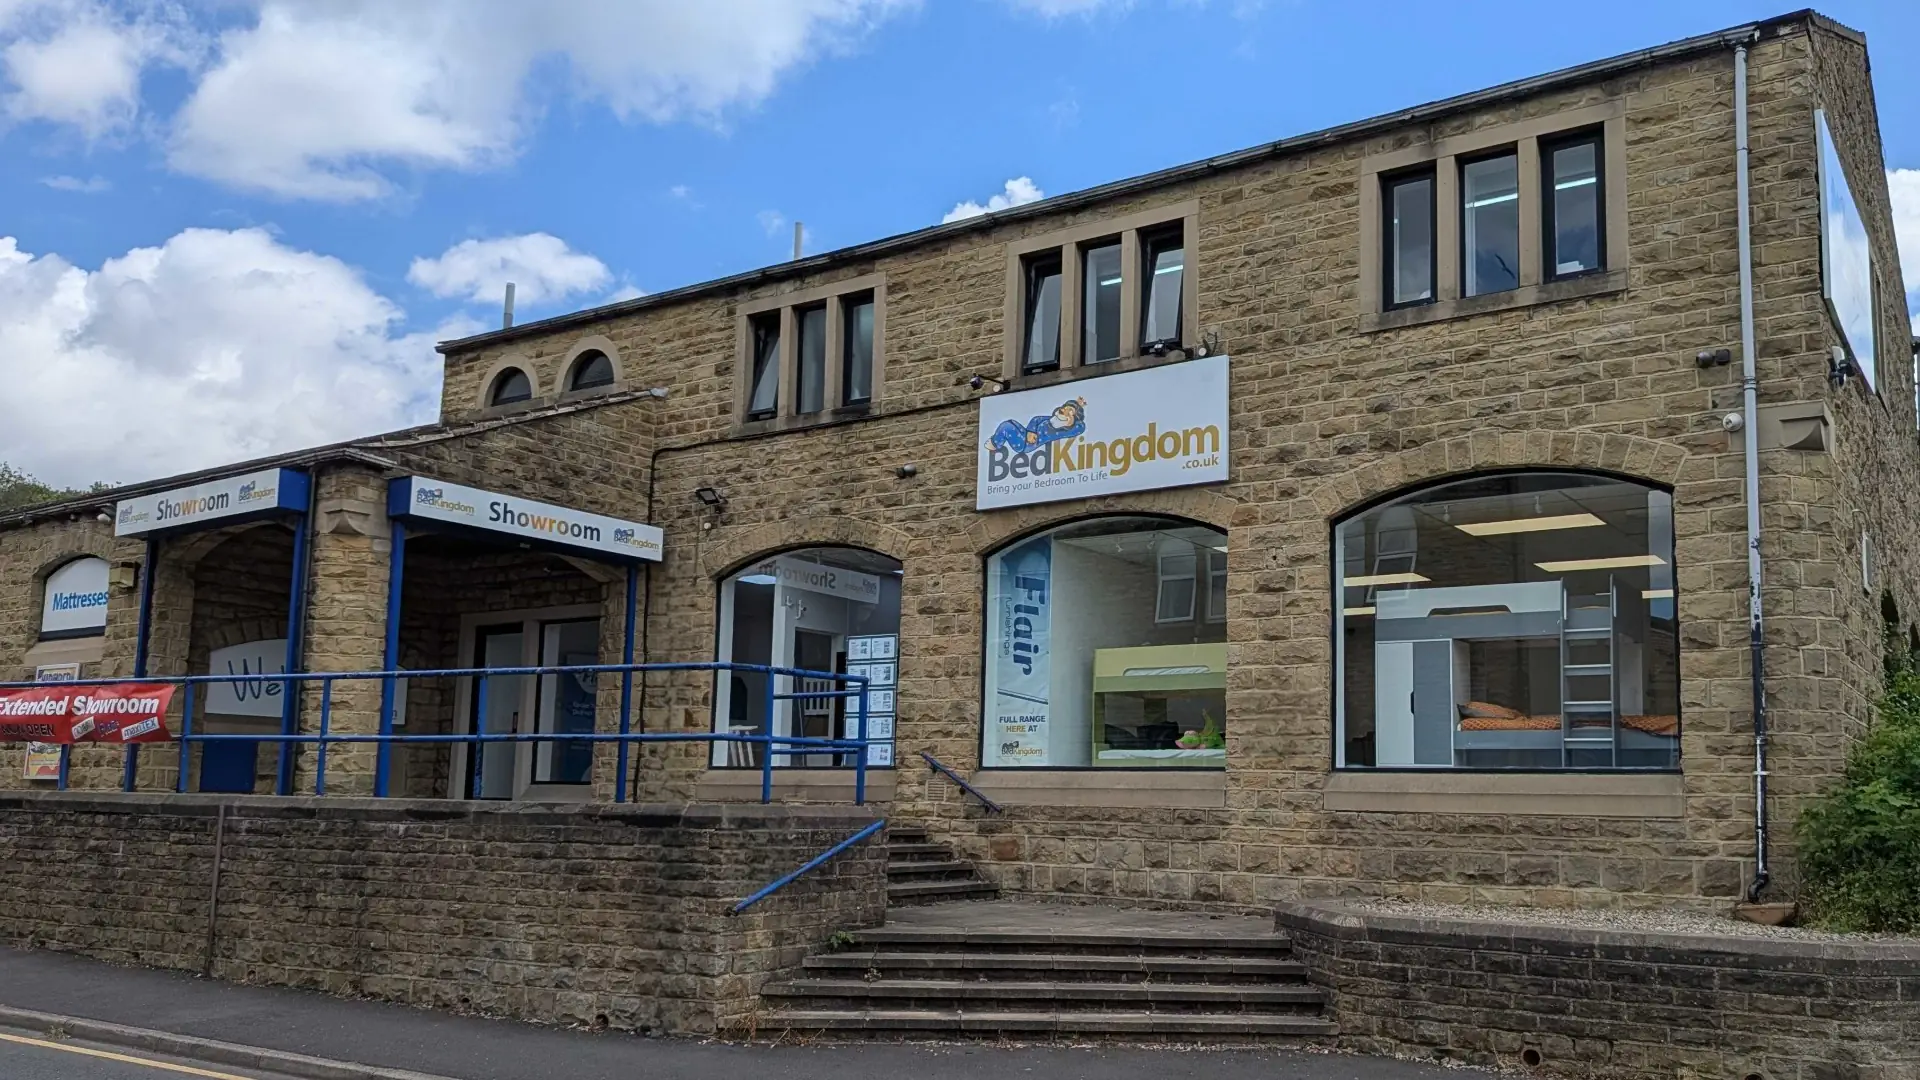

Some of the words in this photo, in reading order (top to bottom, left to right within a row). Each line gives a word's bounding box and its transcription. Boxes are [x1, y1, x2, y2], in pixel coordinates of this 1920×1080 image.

[987, 422, 1219, 482] BedKingdom
[1182, 455, 1219, 470] .co.uk
[987, 485, 1010, 495] Bring
[1012, 482, 1033, 493] your
[1034, 476, 1075, 488] Bedroom
[1077, 473, 1089, 482] To
[1090, 470, 1108, 481] Life
[156, 491, 229, 521] Showroom
[489, 501, 600, 542] Showroom
[52, 590, 110, 611] Mattresses
[1013, 575, 1046, 676] Flair
[71, 695, 160, 715] Showroom
[999, 716, 1018, 724] FULL
[1019, 715, 1046, 723] RANGE
[1006, 725, 1025, 733] HERE
[1028, 724, 1038, 732] AT
